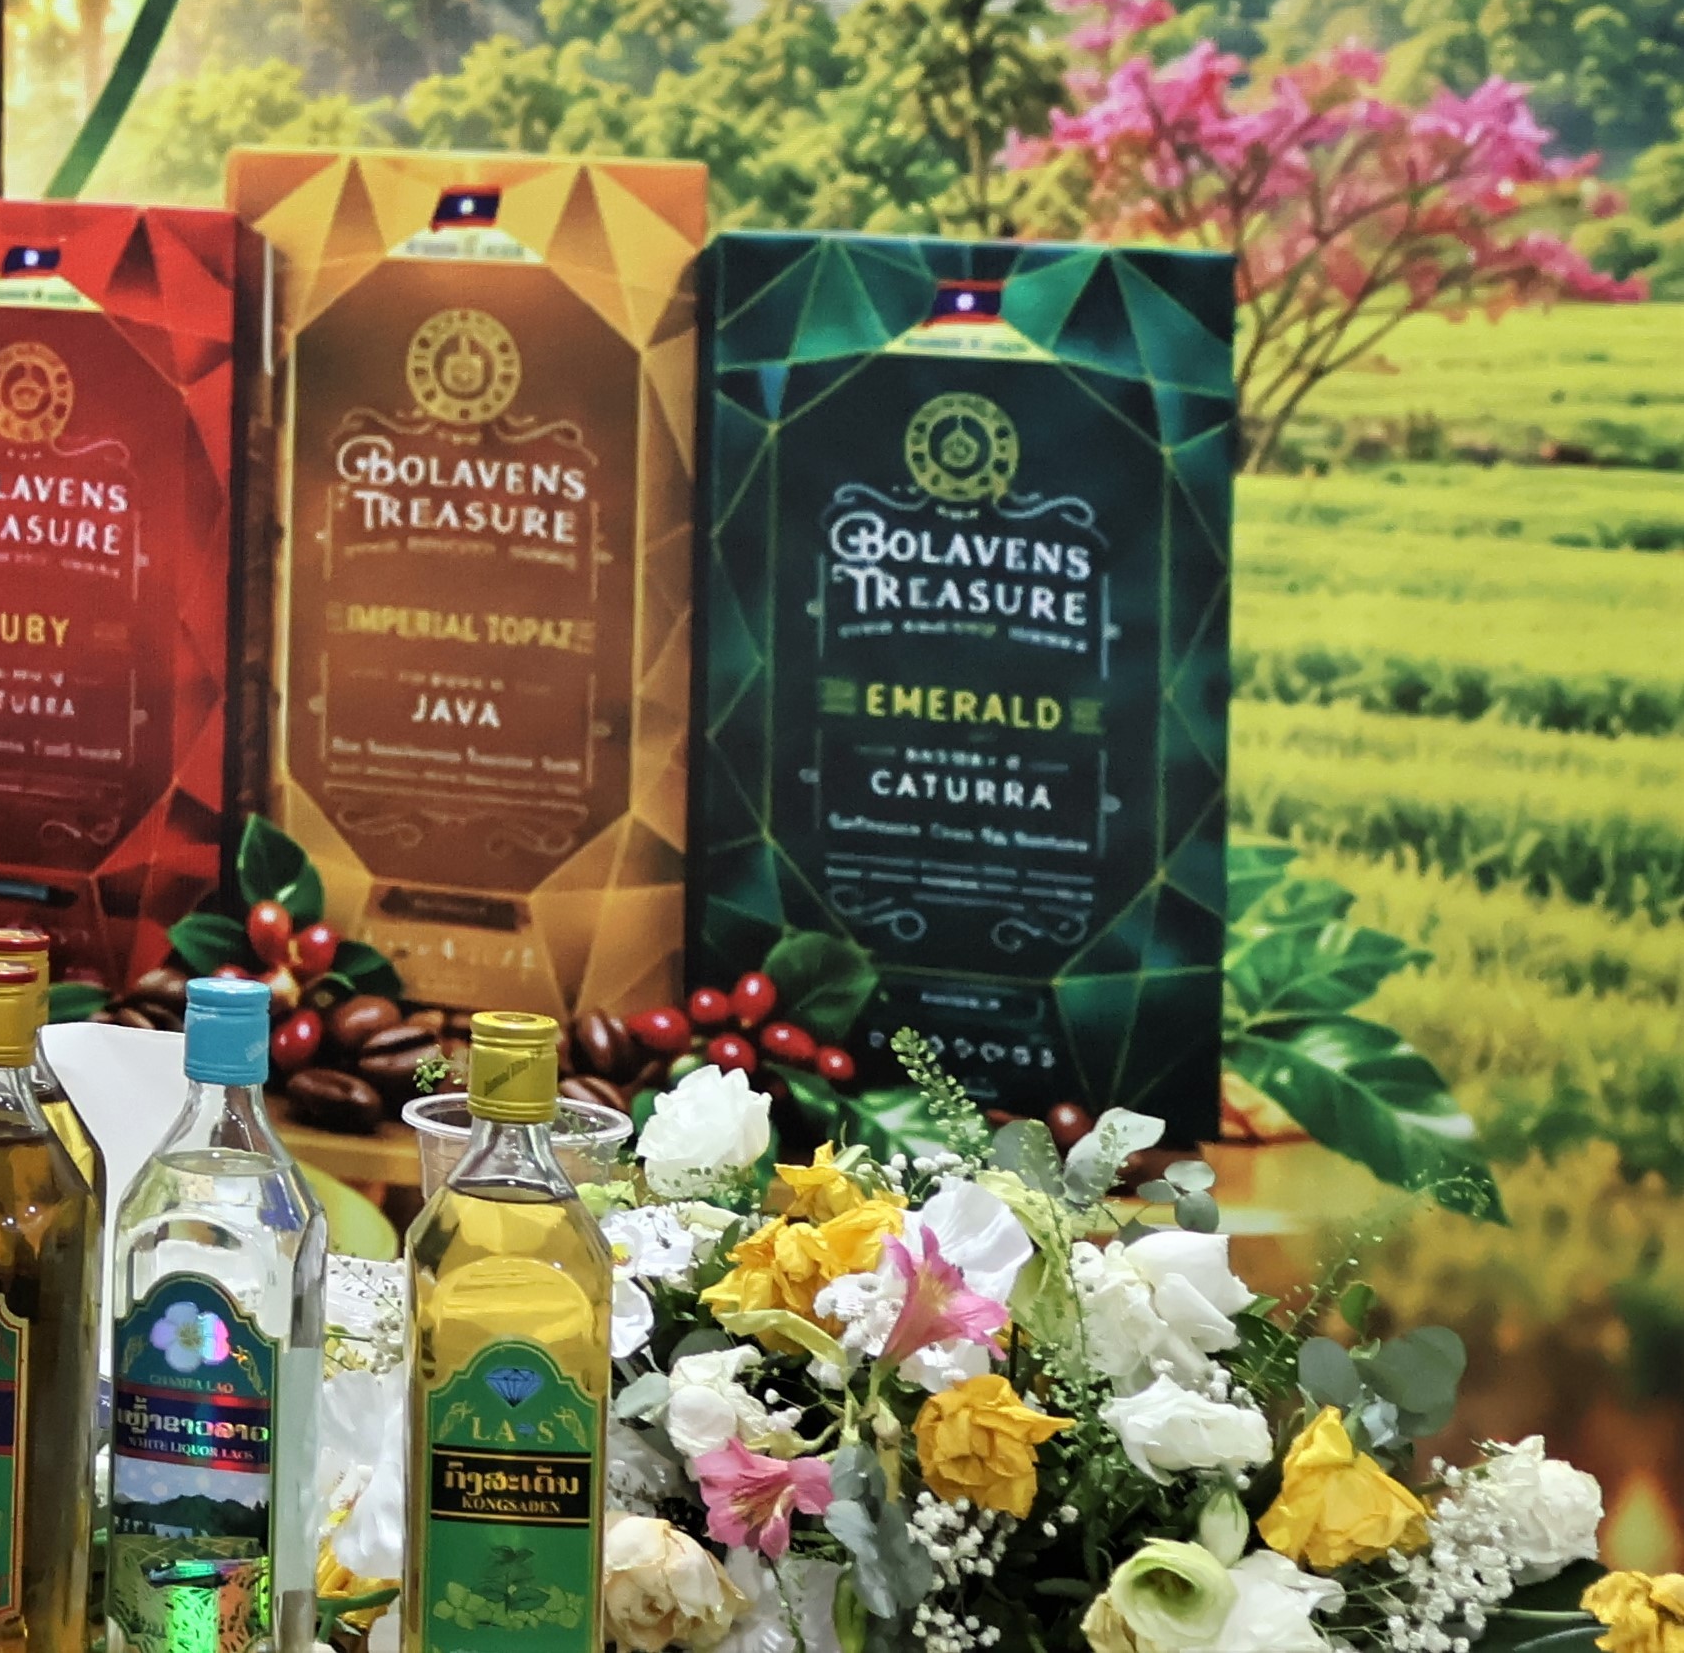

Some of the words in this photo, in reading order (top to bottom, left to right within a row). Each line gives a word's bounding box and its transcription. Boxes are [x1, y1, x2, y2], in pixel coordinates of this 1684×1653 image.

[336, 434, 588, 502] BOLAVENS
[352, 489, 578, 544] TREASURE
[829, 510, 1092, 581] BOLAVENS
[831, 564, 1089, 627] TREASURE
[344, 603, 480, 644] IMPERIAL
[486, 613, 576, 649] TOPAZ
[411, 692, 502, 730] JAVA
[866, 682, 1063, 731] EMERALD
[870, 769, 1053, 812] CATURRA
[148, 1374, 204, 1391] CHAMPA
[205, 1380, 235, 1394] LAO
[128, 1436, 169, 1452] WHITE
[170, 1441, 220, 1458] LIQUOR
[221, 1448, 255, 1460] LAOS
[460, 1495, 562, 1515] KONGSADEN
